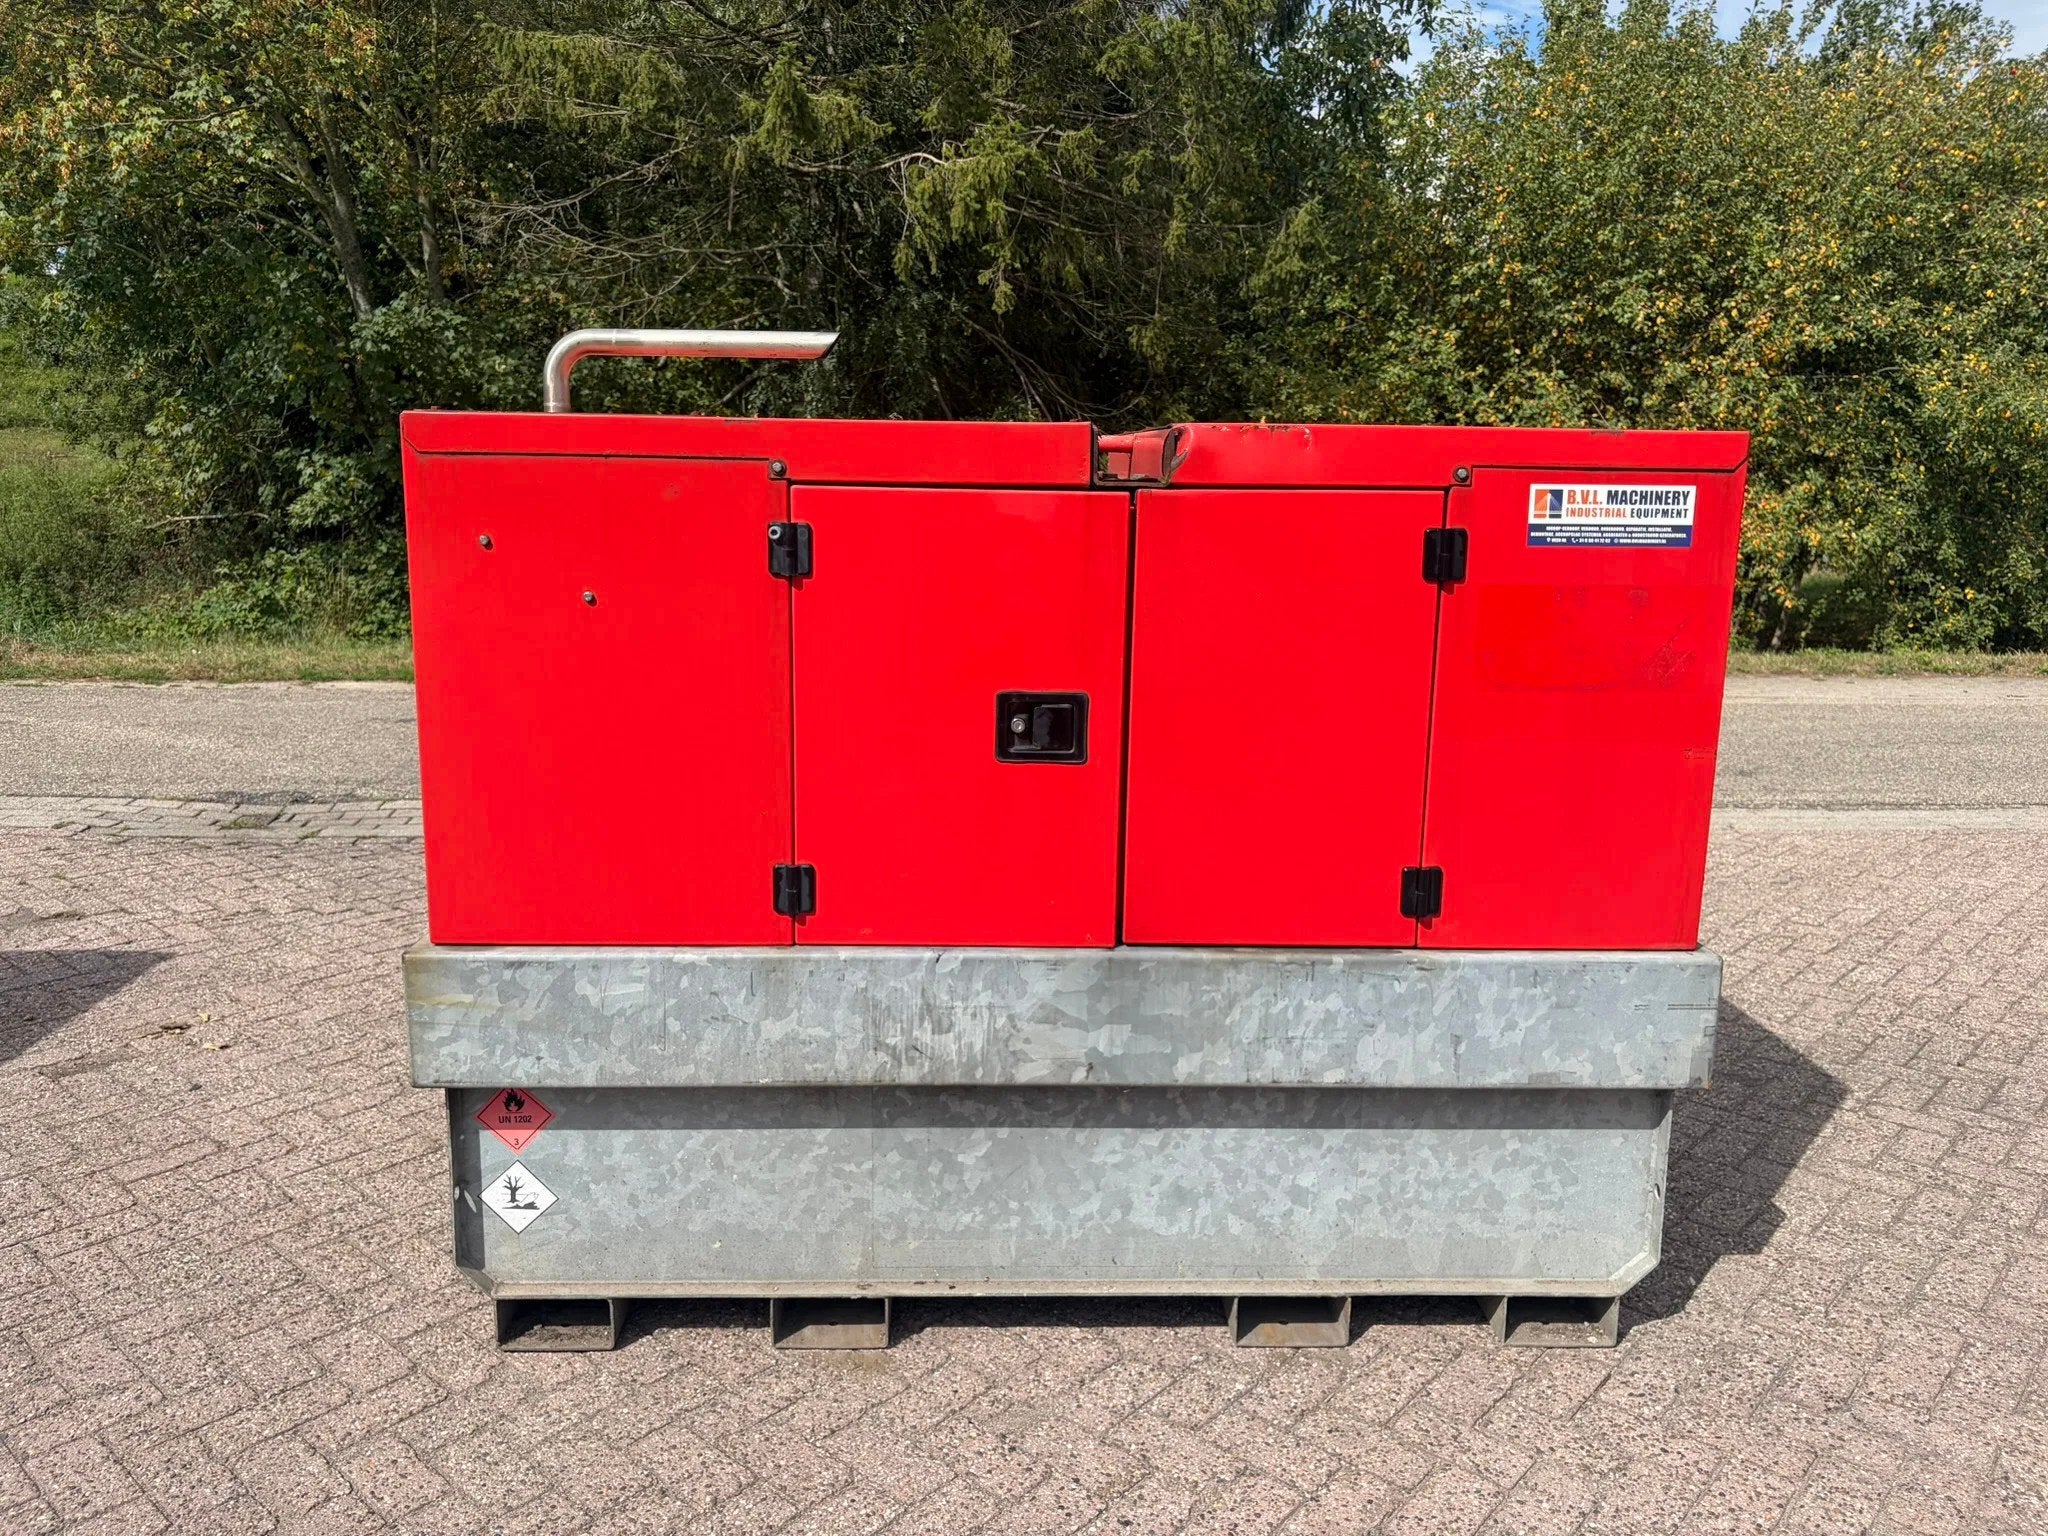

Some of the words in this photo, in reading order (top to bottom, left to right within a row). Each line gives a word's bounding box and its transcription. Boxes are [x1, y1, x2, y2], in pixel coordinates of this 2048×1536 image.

[1567, 489, 1603, 505] B.V.L.
[1606, 490, 1691, 506] MACHINERY
[1565, 507, 1627, 518] INDUSTRIAL
[1630, 508, 1689, 519] EQUIPMENT
[498, 1115, 512, 1124] UN
[514, 1115, 532, 1123] 1202
[514, 1138, 520, 1146] 3
